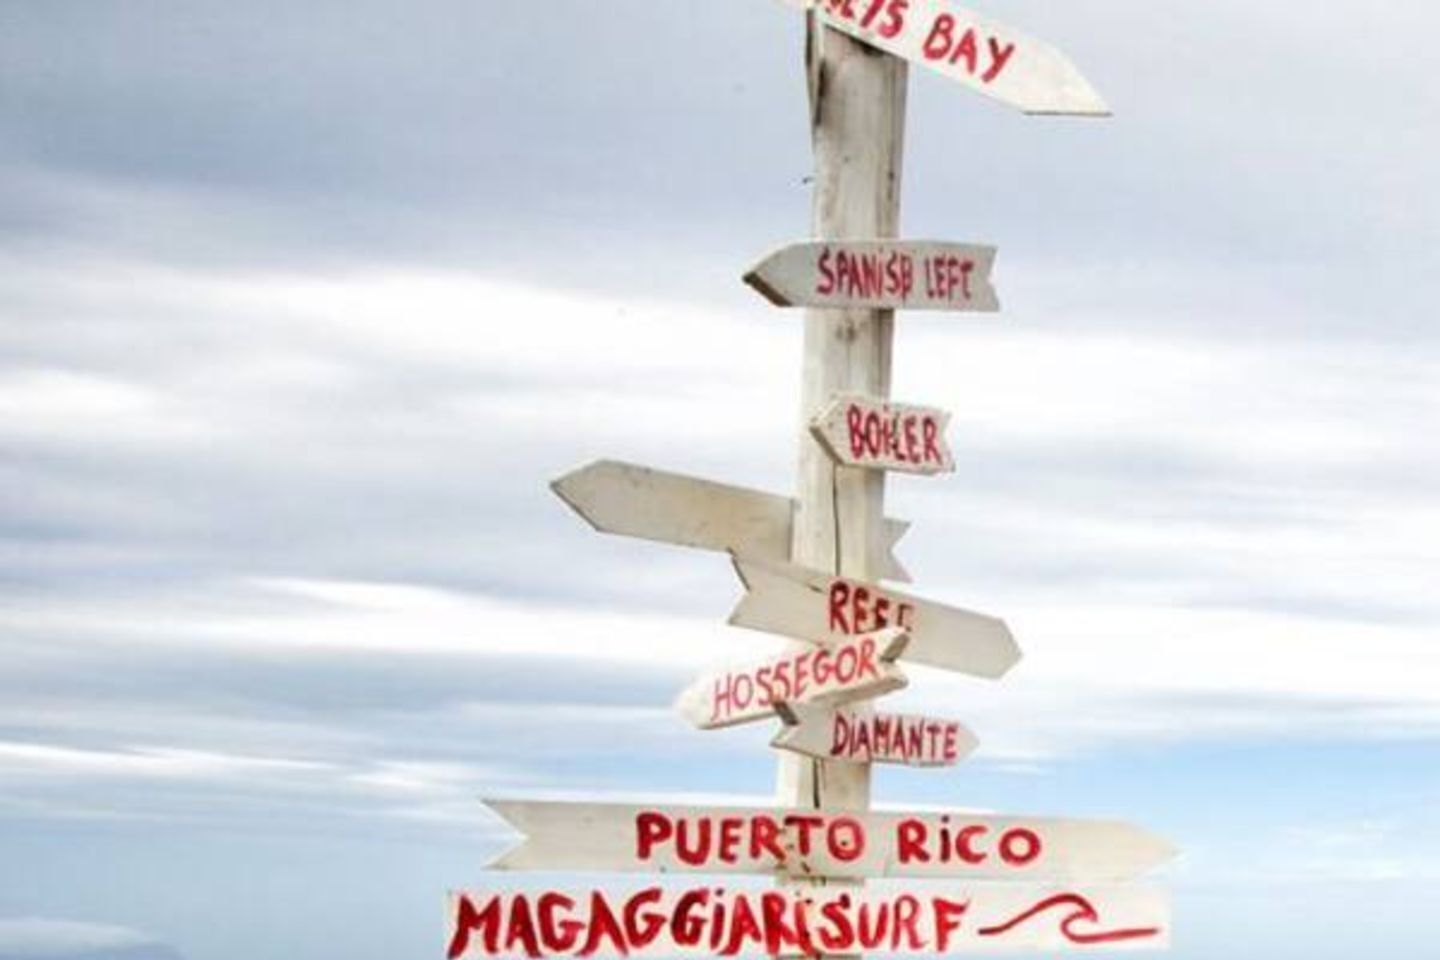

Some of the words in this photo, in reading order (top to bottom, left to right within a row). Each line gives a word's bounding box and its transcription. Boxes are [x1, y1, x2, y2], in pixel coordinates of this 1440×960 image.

[922, 12, 1015, 84] BAY
[924, 254, 976, 301] LEFT
[712, 637, 878, 722] HOSSEGOR
[635, 809, 868, 868] PUERTO
